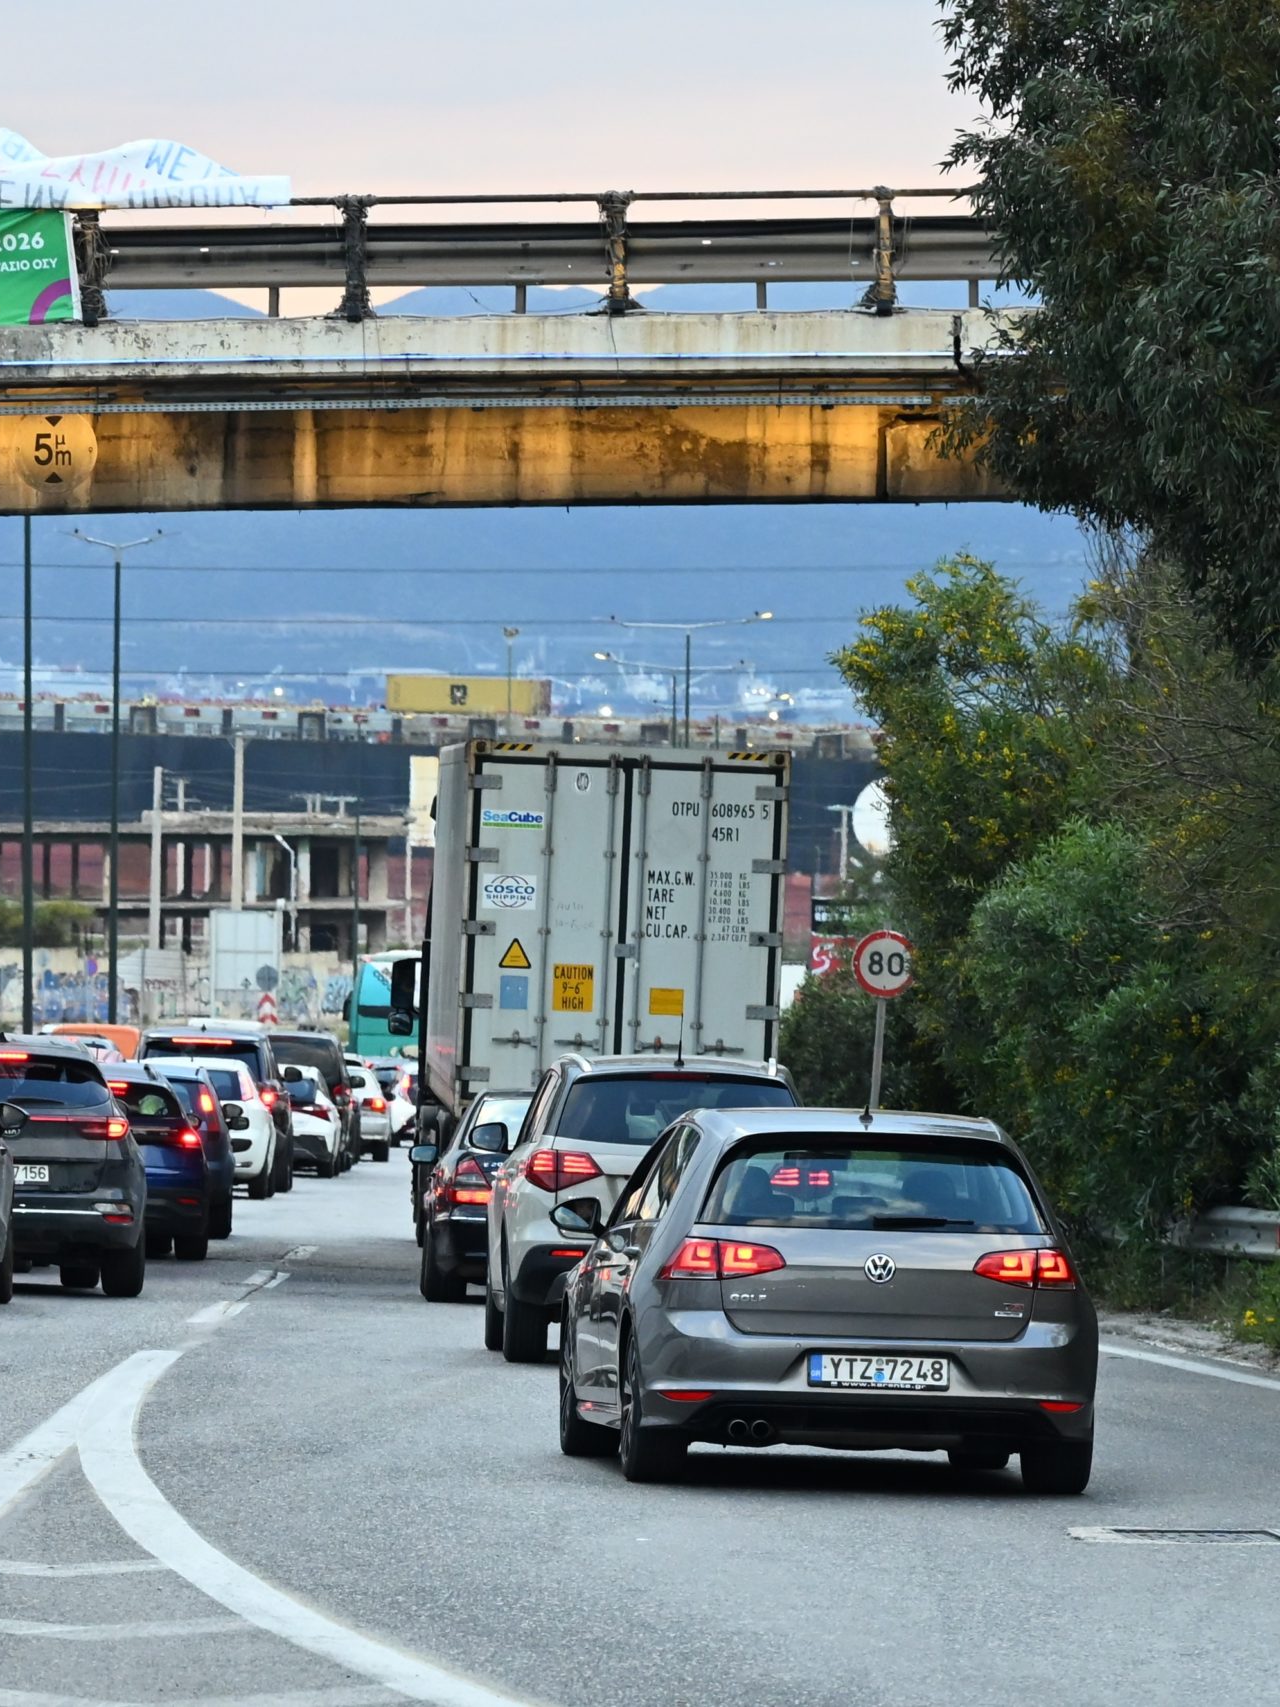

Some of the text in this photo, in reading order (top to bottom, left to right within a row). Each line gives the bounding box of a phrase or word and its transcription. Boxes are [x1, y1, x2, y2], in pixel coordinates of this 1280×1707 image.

[32, 258, 58, 270] ΟΣΥ
[34, 433, 53, 466] 5
[483, 810, 543, 823] SeaCube
[672, 802, 769, 819] OTPU 608965 5
[712, 827, 740, 841] 45R1
[484, 885, 535, 894] COSCO
[648, 888, 675, 903] TARE
[646, 906, 666, 920] NET
[868, 951, 904, 976] 80
[553, 965, 594, 980] CAUTION
[562, 996, 584, 1010] HIGH
[730, 1293, 767, 1302] GOLF
